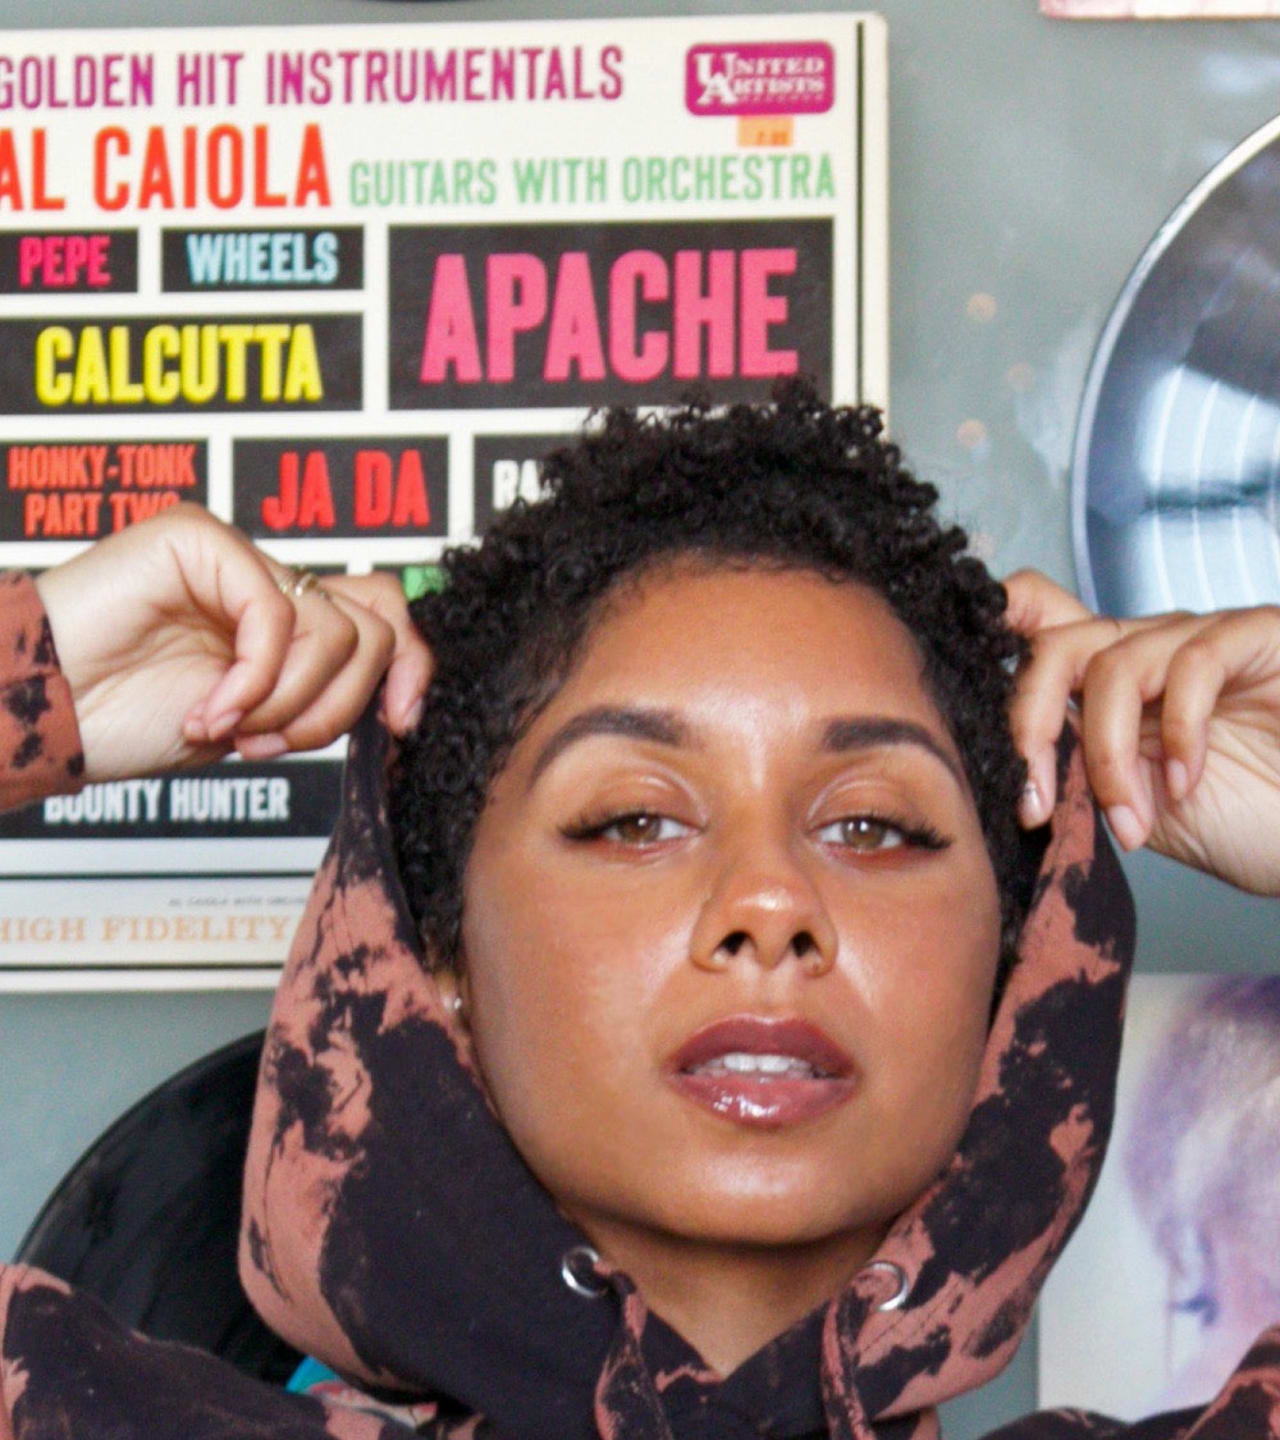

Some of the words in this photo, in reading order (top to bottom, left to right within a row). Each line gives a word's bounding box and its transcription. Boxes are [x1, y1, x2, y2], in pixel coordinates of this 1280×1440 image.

[177, 52, 244, 107] HIT
[267, 45, 624, 103] INSTRUMENTALS
[694, 53, 825, 83] UNITED
[696, 72, 825, 105] ARTISTS
[94, 123, 332, 210] CAIOLA
[349, 159, 496, 207] GUITARS
[513, 156, 608, 205] WITH
[623, 153, 837, 203] ORCHESTRA
[19, 235, 111, 287] PEPE
[186, 232, 339, 286] WHEELS
[419, 248, 800, 384] APACHE
[36, 324, 323, 406] CALCUTTA
[8, 443, 197, 489] HONKY-TONK
[262, 450, 337, 531] JA
[354, 449, 431, 527] DA
[25, 491, 103, 537] PART
[43, 778, 163, 824] BOUNTY
[169, 776, 291, 824] HUNTER
[101, 914, 291, 943] FIDELITY
